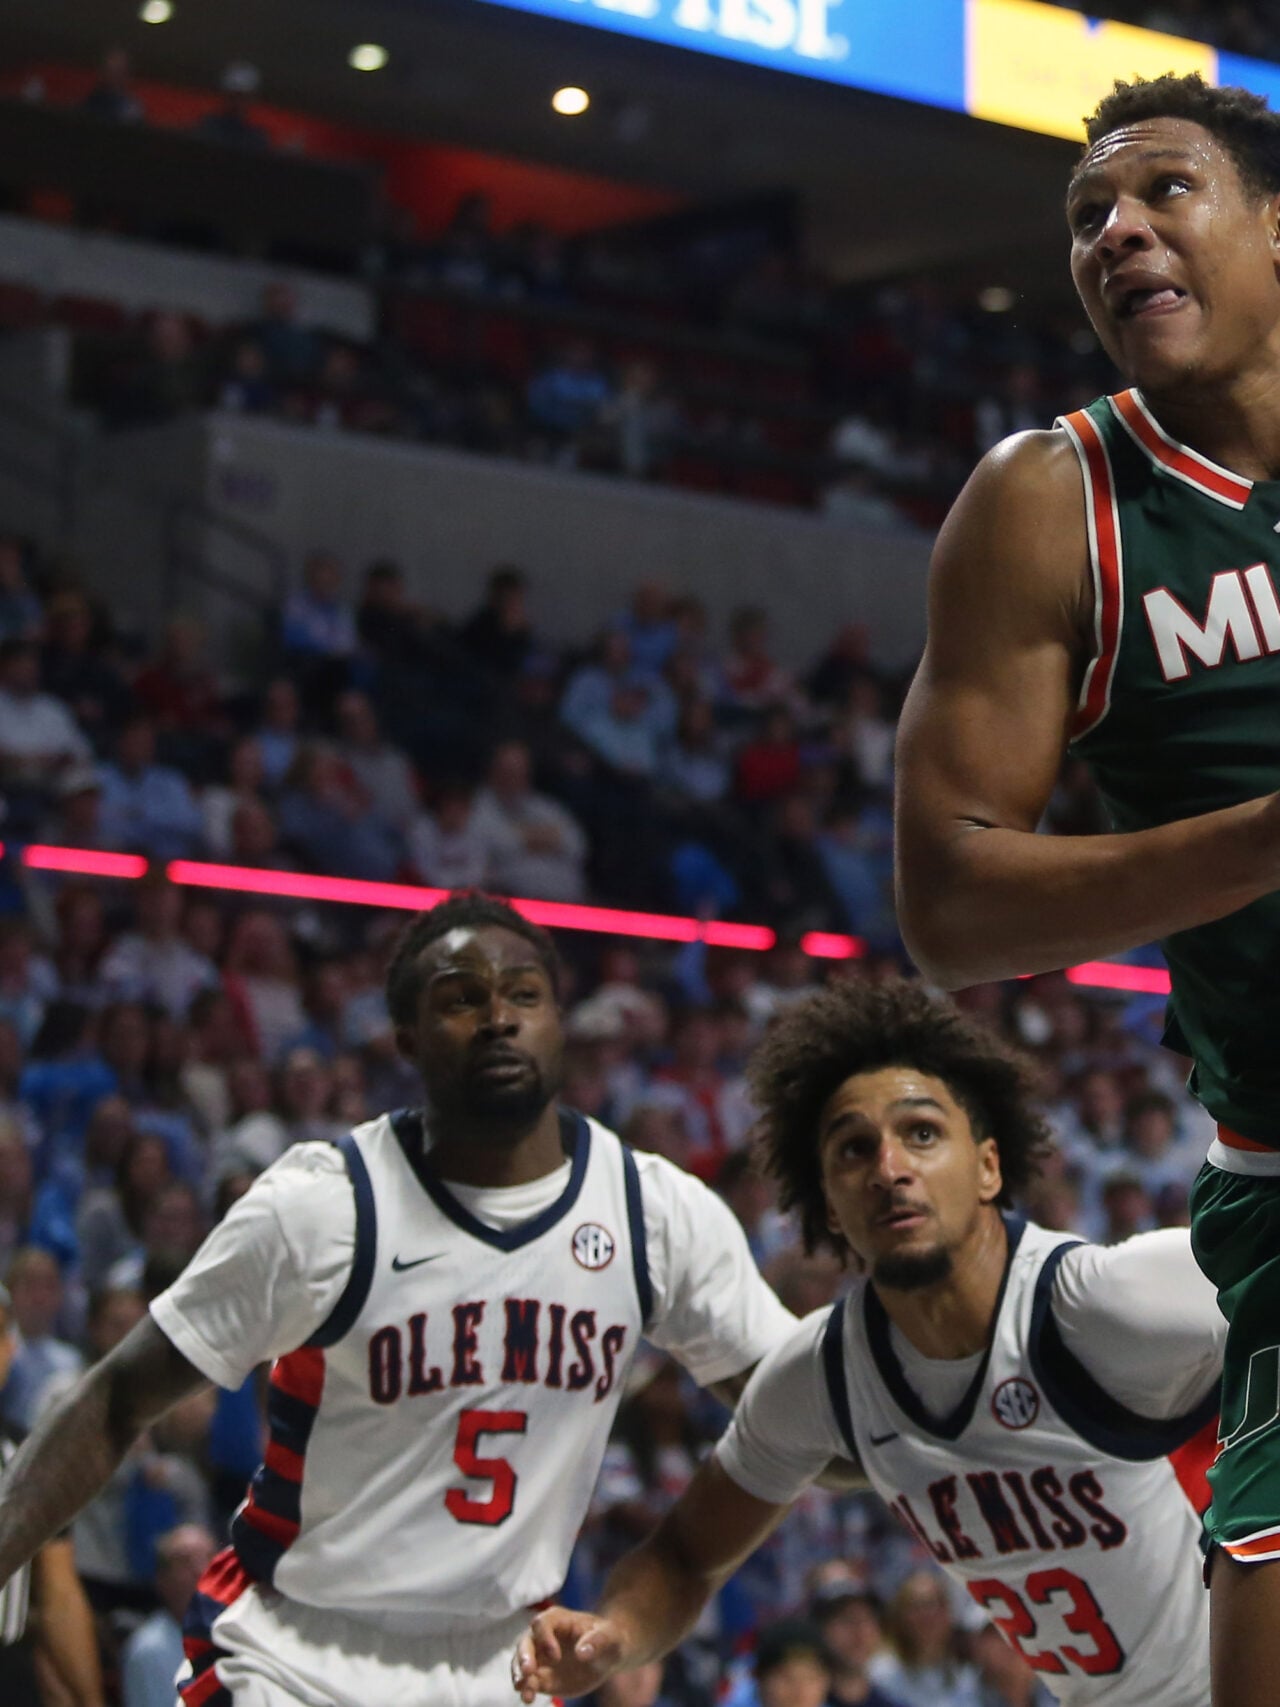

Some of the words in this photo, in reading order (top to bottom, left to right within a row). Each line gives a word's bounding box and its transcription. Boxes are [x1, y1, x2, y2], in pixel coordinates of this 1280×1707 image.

[368, 1301, 486, 1405] OLE
[501, 1298, 627, 1405] MISS
[444, 1409, 528, 1527] 5
[889, 1473, 984, 1565] LE
[965, 1466, 1129, 1555] MISS
[966, 1567, 1126, 1678] 23
